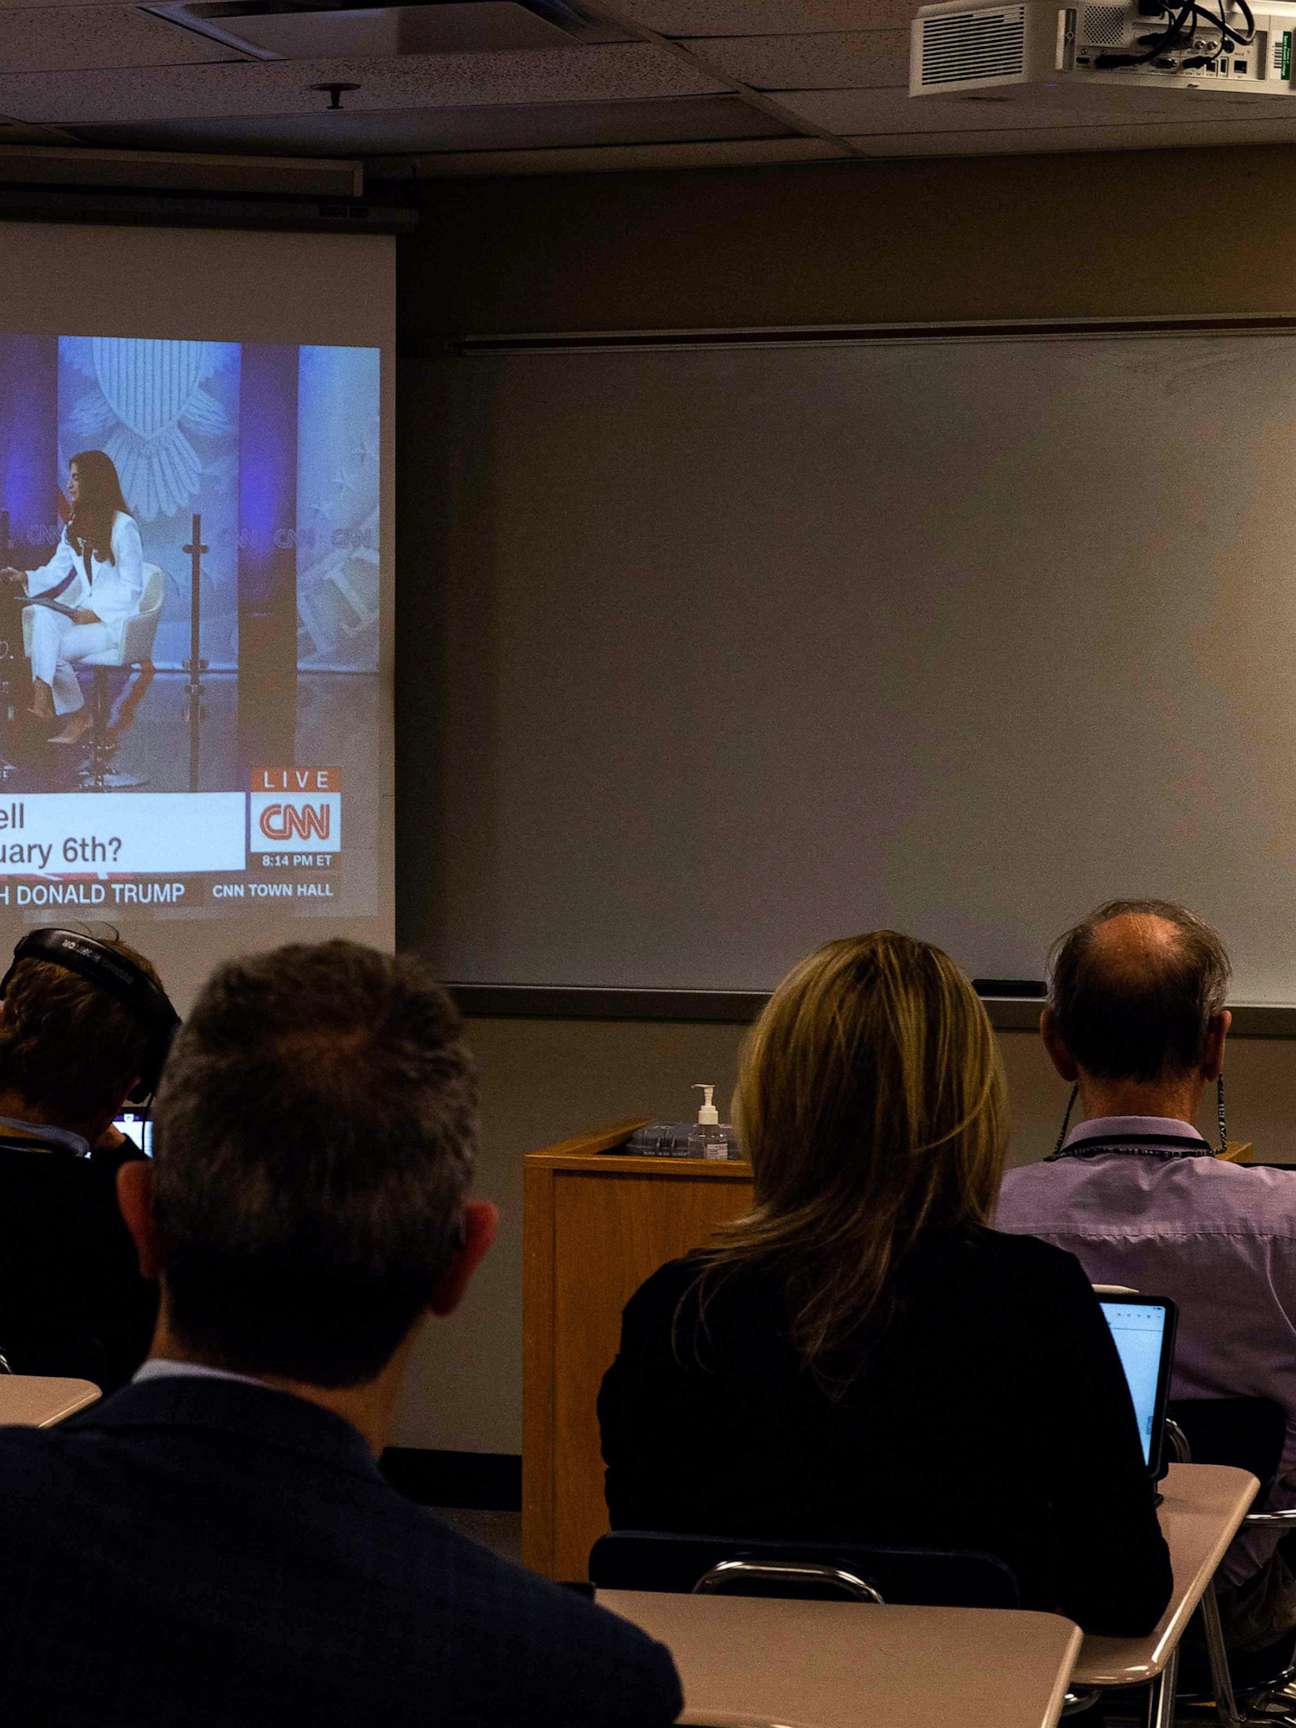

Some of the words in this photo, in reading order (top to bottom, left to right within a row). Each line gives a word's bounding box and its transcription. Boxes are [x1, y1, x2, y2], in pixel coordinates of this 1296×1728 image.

[263, 771, 329, 788] LIVE
[259, 804, 329, 840] CNN
[62, 837, 122, 863] 6th?
[262, 855, 289, 867] 8:14
[293, 855, 313, 867] PM
[316, 855, 333, 866] ET
[16, 884, 106, 905] DONALD
[110, 883, 186, 903] TRUMP
[212, 884, 245, 898] CNN
[247, 884, 294, 897] TOWN
[296, 884, 334, 896] HALL
